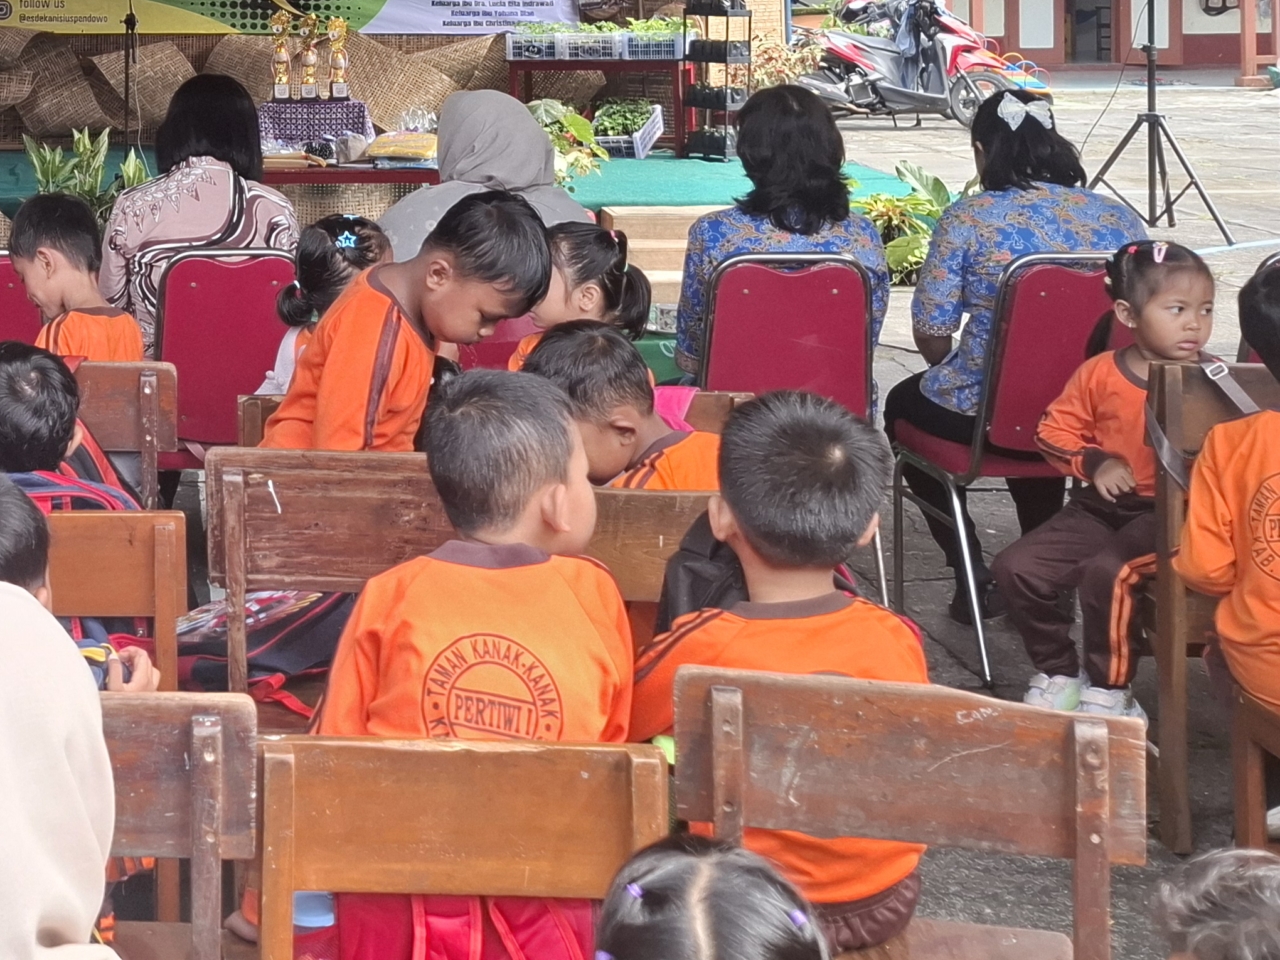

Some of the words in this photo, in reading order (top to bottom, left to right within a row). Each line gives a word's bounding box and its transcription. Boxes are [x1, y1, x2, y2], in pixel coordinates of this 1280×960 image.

[54, 0, 66, 9] us
[426, 646, 468, 696] TAMAN
[454, 692, 522, 734] PERTIWI
